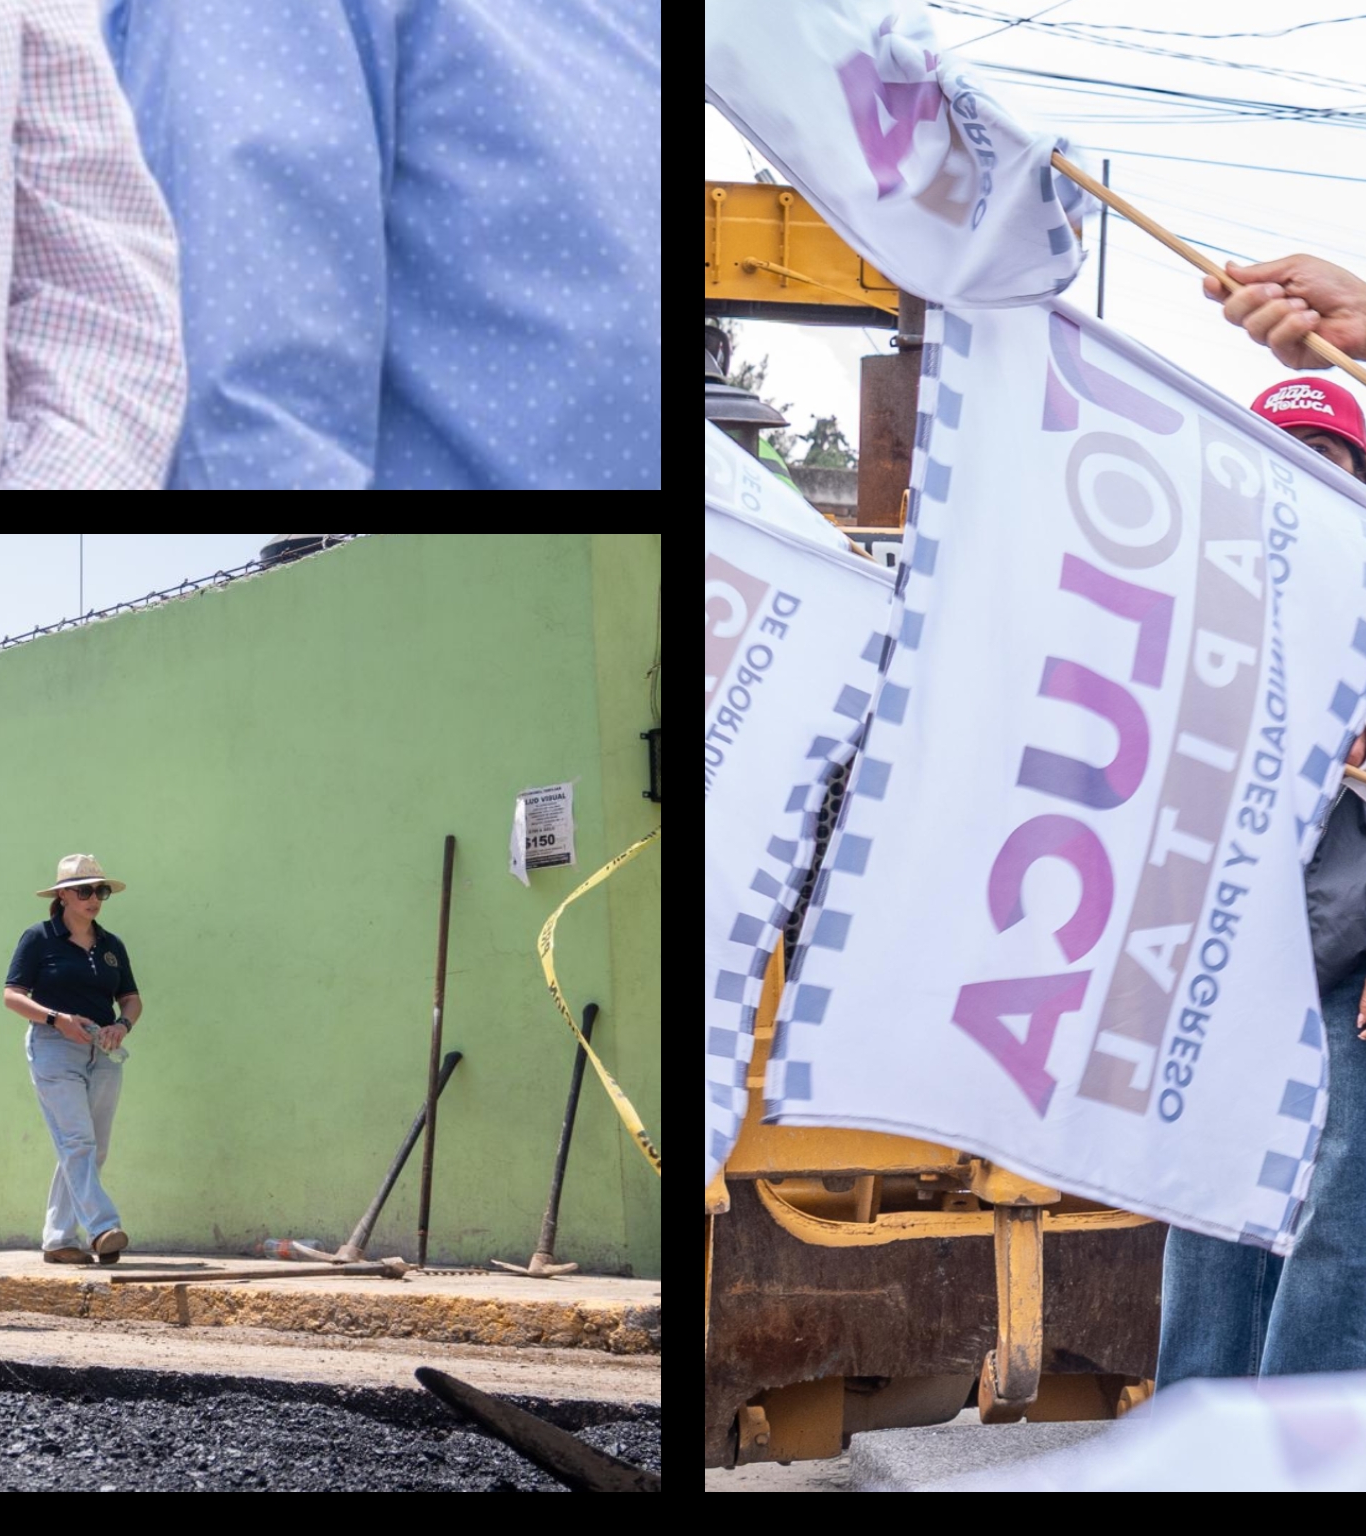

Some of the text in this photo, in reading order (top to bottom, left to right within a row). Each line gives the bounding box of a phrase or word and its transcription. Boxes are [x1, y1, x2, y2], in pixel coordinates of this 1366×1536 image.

[1272, 399, 1335, 416] TOLUCA
[525, 792, 566, 806] LUD VISUAL
